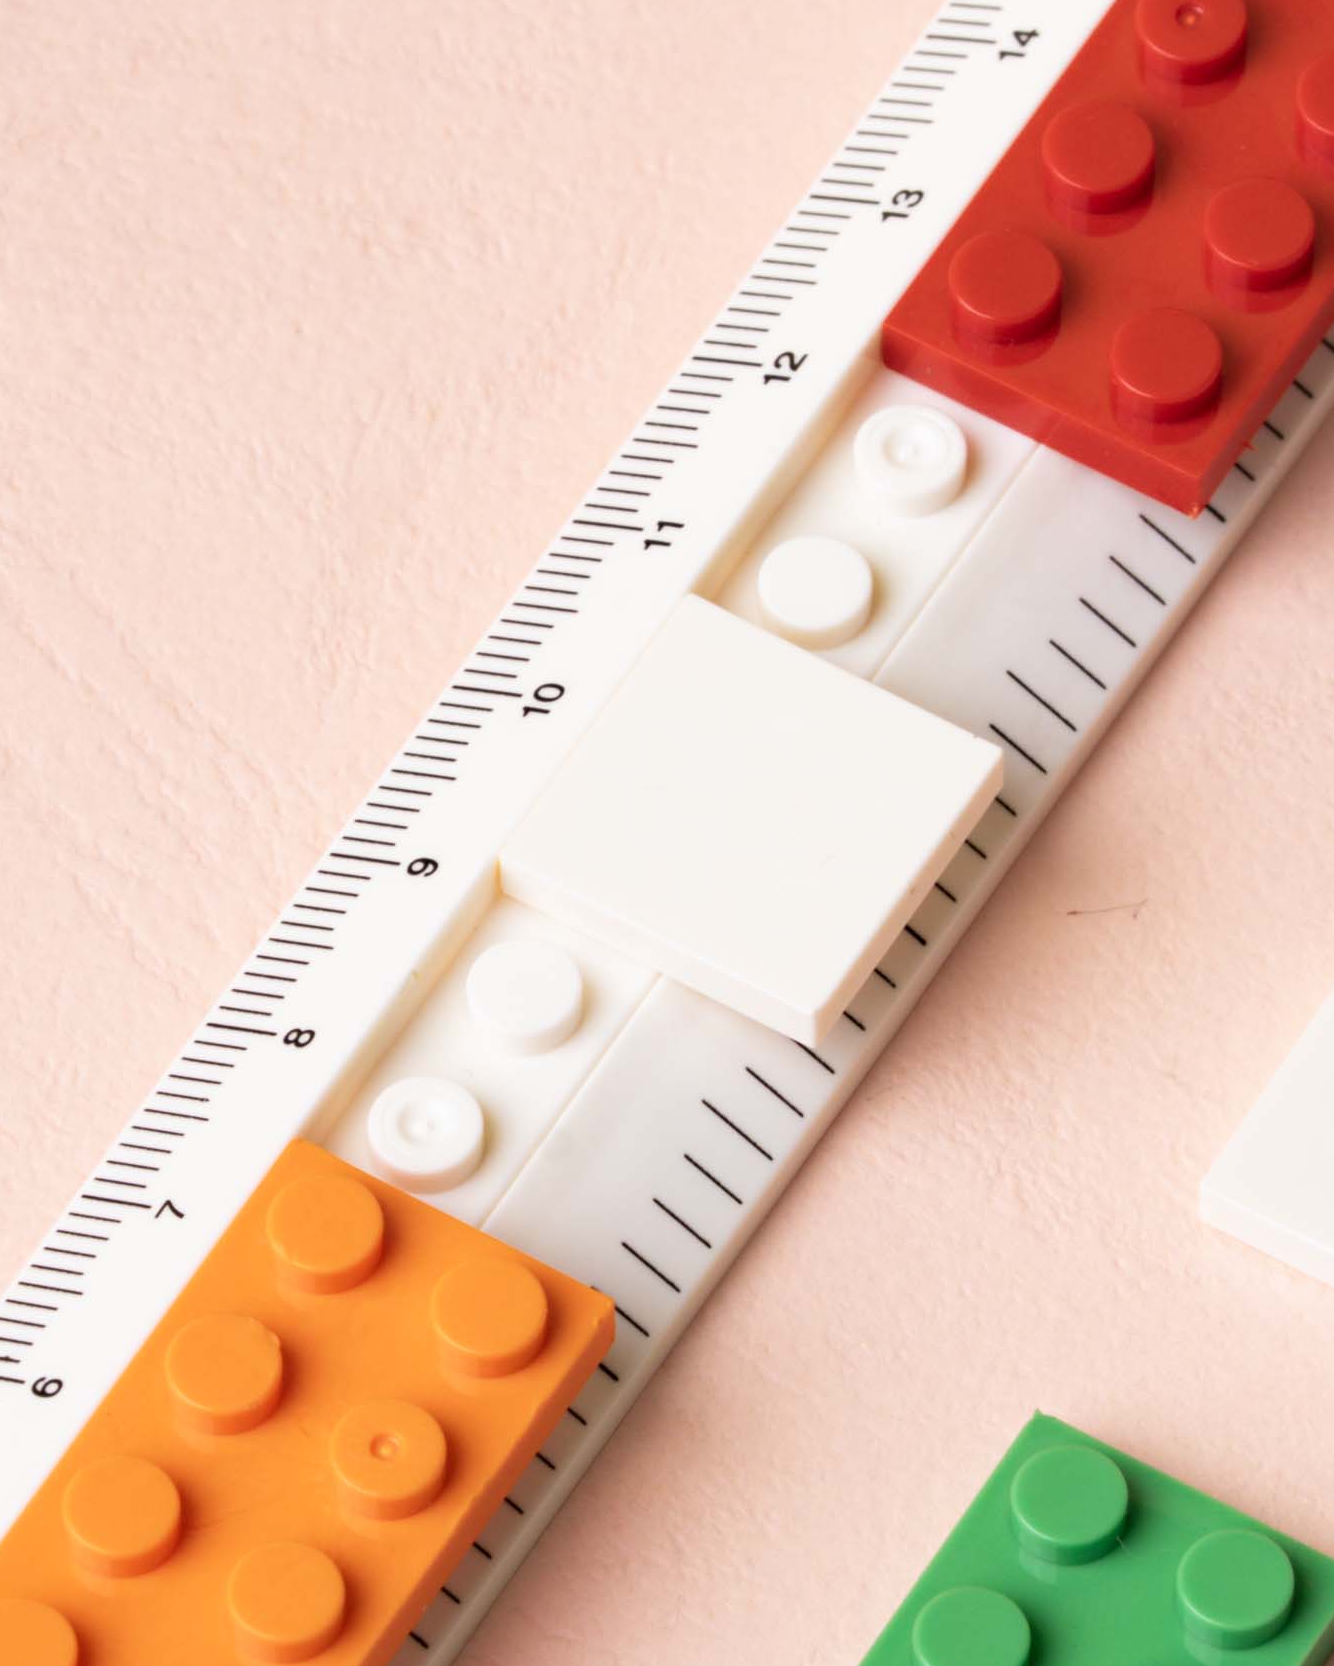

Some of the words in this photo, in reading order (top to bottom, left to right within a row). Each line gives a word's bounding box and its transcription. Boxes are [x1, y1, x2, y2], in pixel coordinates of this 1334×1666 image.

[999, 30, 1040, 61] 14
[881, 188, 925, 222] 13
[762, 351, 808, 385] 12
[643, 519, 686, 551] 11
[522, 683, 566, 719] 10
[406, 856, 439, 878] 9
[282, 1028, 316, 1049] 8
[154, 1199, 186, 1220] 7
[31, 1376, 64, 1399] 6
